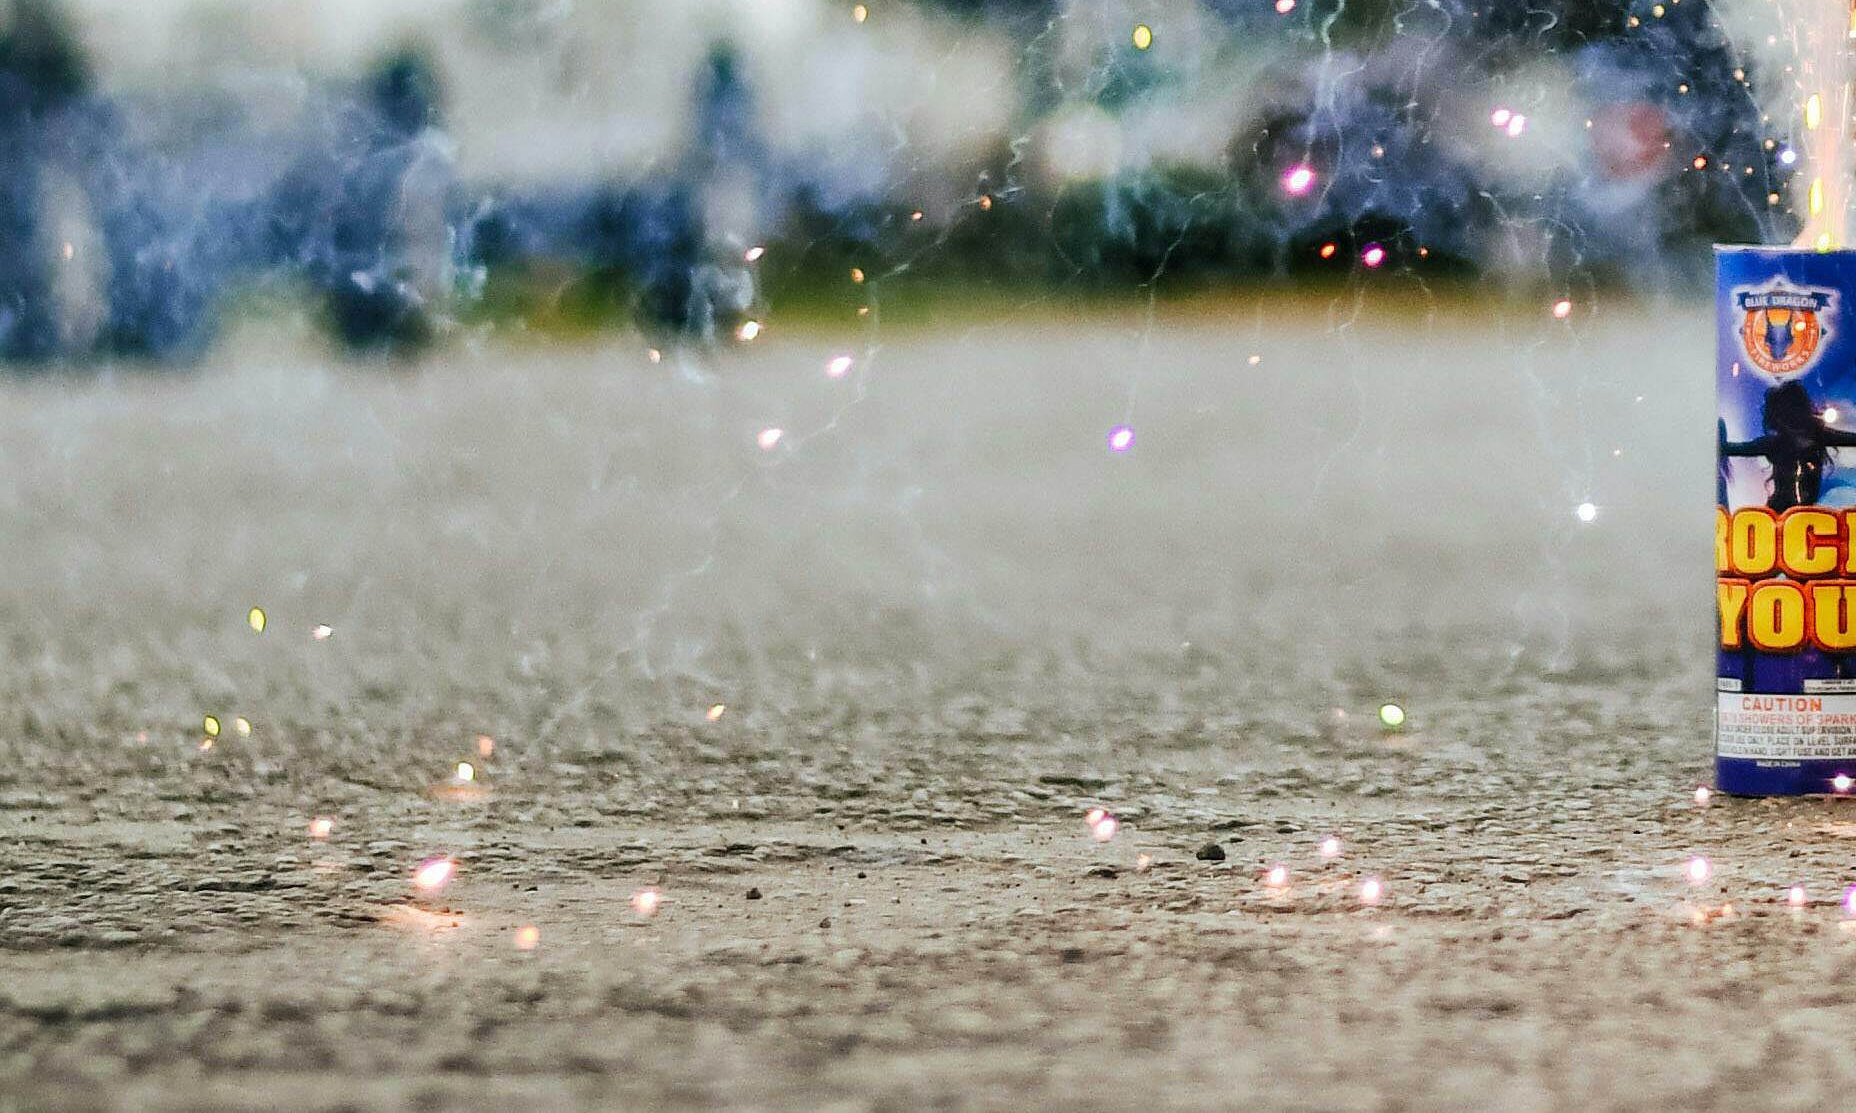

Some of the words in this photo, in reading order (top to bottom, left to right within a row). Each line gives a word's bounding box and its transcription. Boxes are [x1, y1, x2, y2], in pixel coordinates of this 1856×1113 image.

[1744, 294, 1769, 308] BLUE
[1771, 293, 1818, 308] DRAGON
[1742, 697, 1823, 712] CAUTION
[1738, 713, 1793, 725] SHOWERS
[1796, 714, 1812, 725] OF
[1776, 726, 1800, 735] ADULT
[1767, 736, 1790, 745] PLACE
[1807, 736, 1831, 746] LEVEL
[1814, 747, 1829, 757] AND
[1831, 747, 1846, 757] GET
